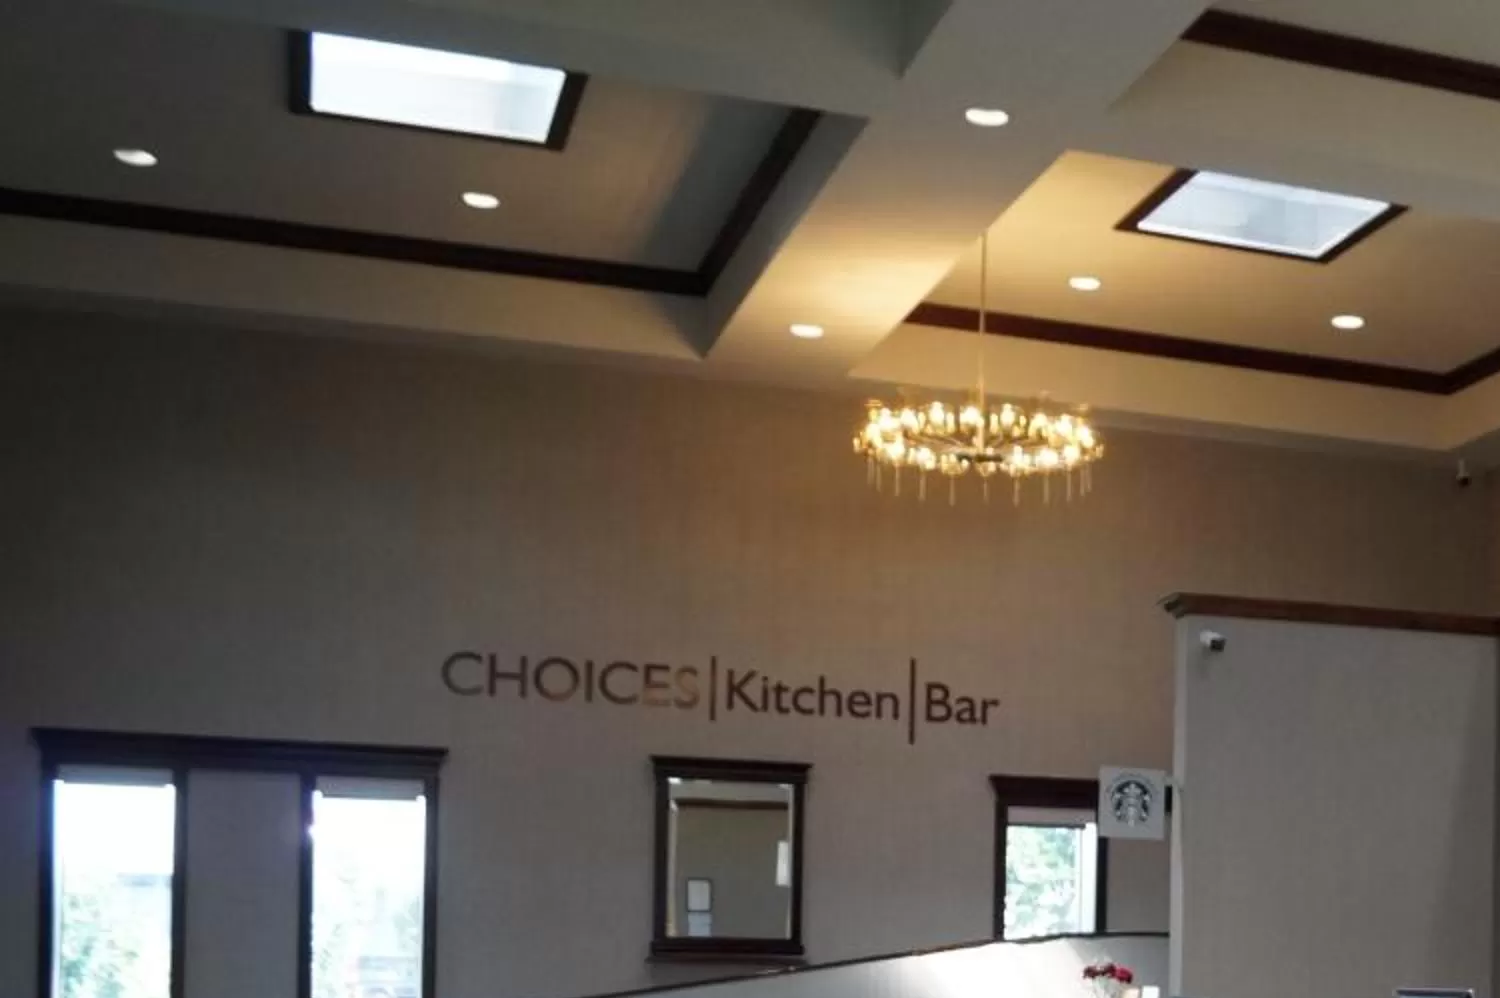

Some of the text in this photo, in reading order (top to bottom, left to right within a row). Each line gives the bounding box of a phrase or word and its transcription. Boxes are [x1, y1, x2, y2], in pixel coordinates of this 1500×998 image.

[441, 651, 999, 726] CHOICES Kitchen Bar
